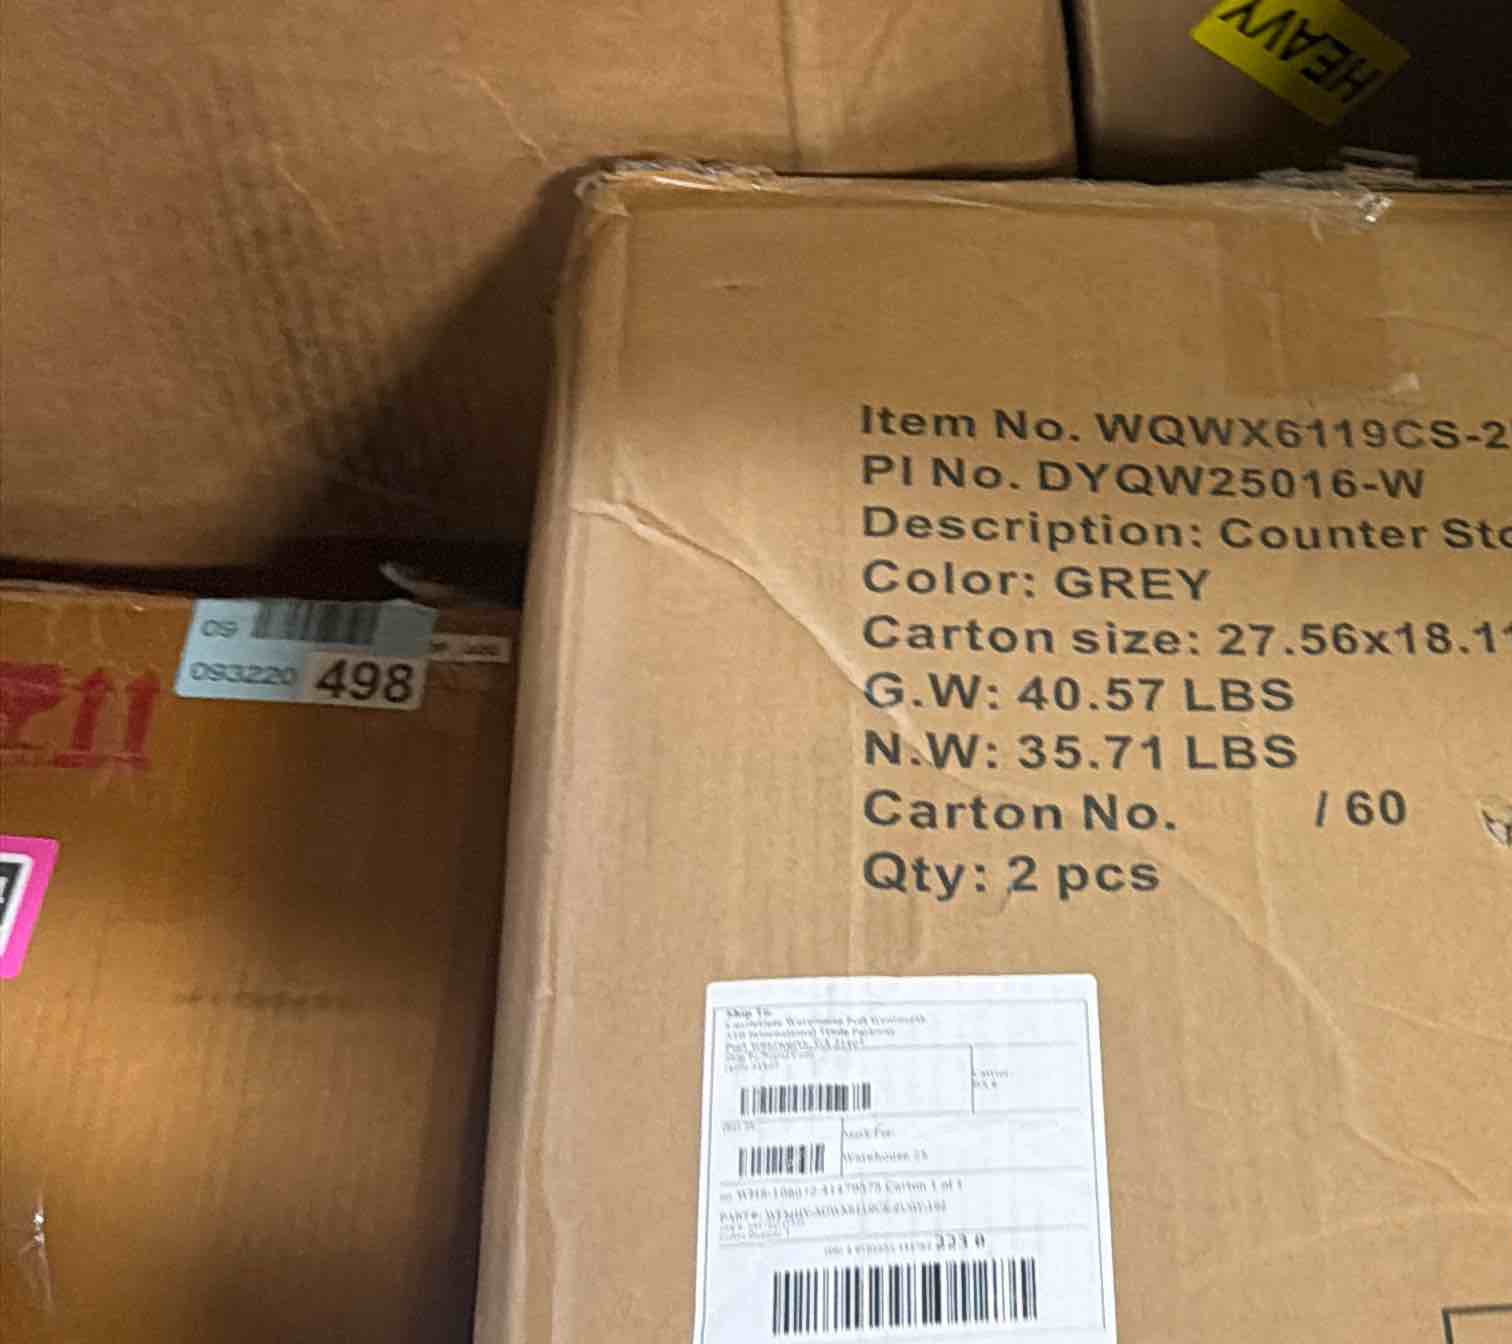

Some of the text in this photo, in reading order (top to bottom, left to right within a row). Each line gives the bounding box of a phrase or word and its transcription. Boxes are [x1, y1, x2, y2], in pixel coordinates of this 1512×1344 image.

[861, 404, 977, 438] Item
[994, 409, 1081, 443] No.
[931, 457, 1020, 490] No.
[1037, 459, 1425, 500] DYQW25016-W
[862, 505, 1202, 553] Description:
[1219, 517, 1429, 551] Counter
[862, 558, 1211, 601] Color: GREY
[861, 614, 1055, 655] Carton
[1071, 620, 1201, 657] size:
[313, 658, 414, 704] 498
[861, 671, 1295, 713] G.W: 40.57 LBS
[864, 729, 1298, 771] N.W: 35.71 LBS
[863, 788, 1063, 832] Carton
[1082, 792, 1177, 832] No.
[1345, 788, 1407, 827] 60
[863, 850, 1160, 903] Qty: 2 pcs
